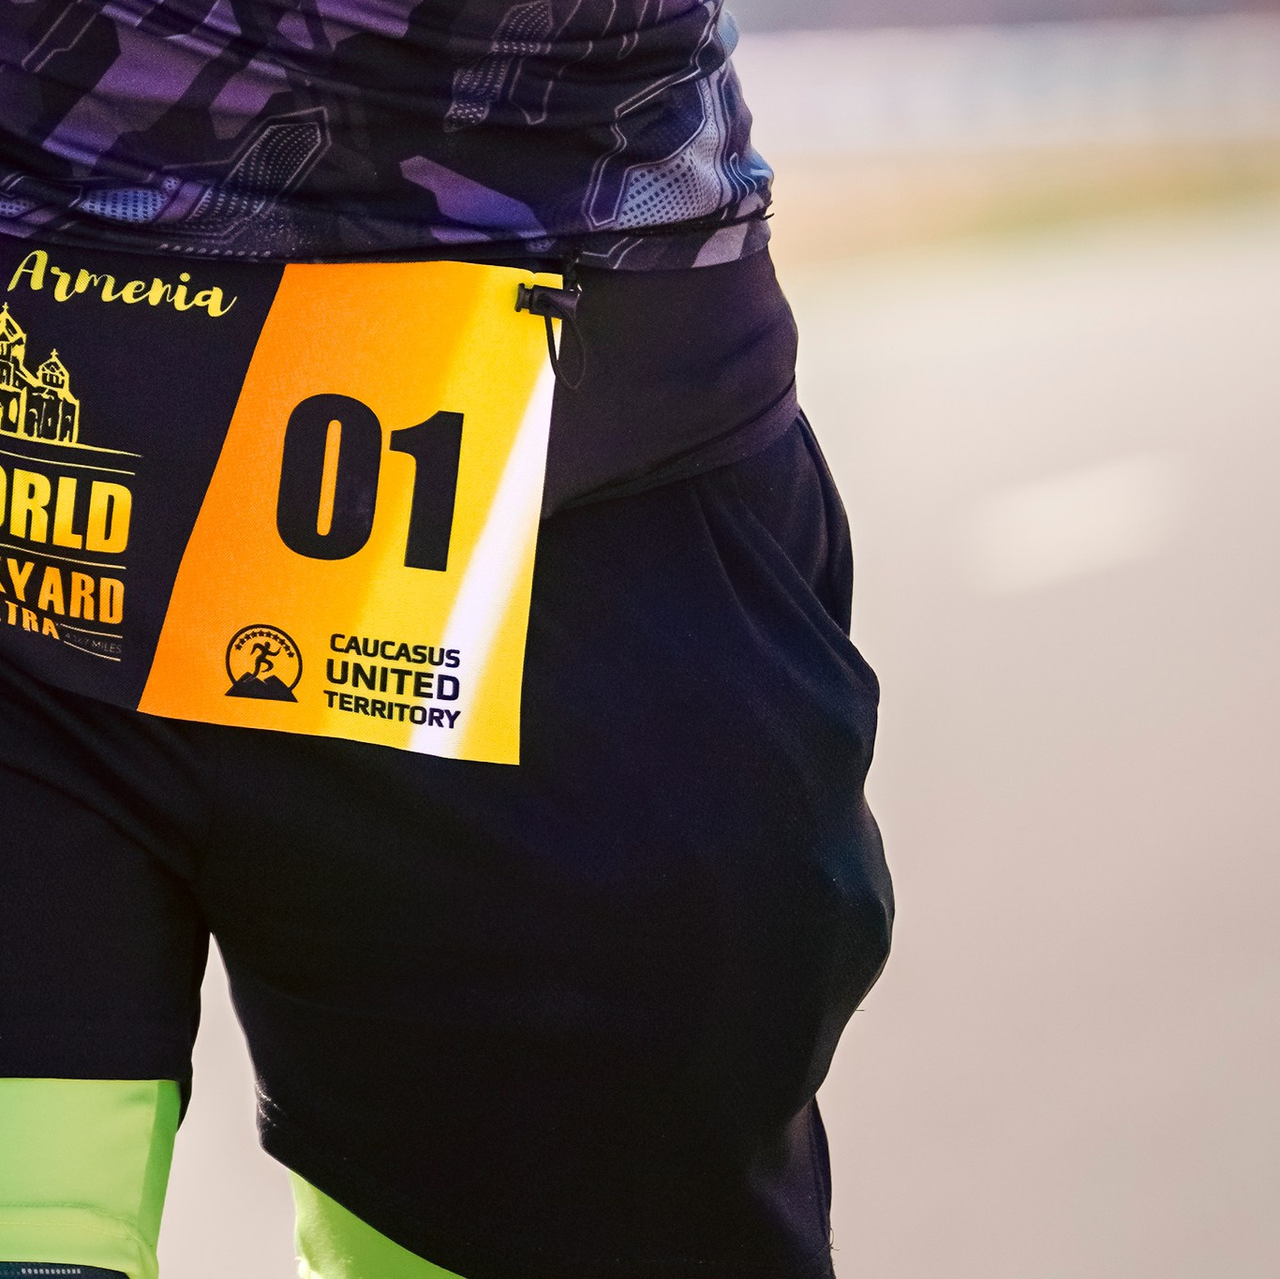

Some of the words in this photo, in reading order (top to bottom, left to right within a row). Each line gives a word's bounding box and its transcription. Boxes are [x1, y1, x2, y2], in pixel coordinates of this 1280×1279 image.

[8, 249, 237, 317] Armenia
[276, 393, 465, 573] 01
[329, 633, 461, 669] CAUCASUS
[326, 658, 461, 702] UNITED
[323, 690, 461, 730] TERRITORY
